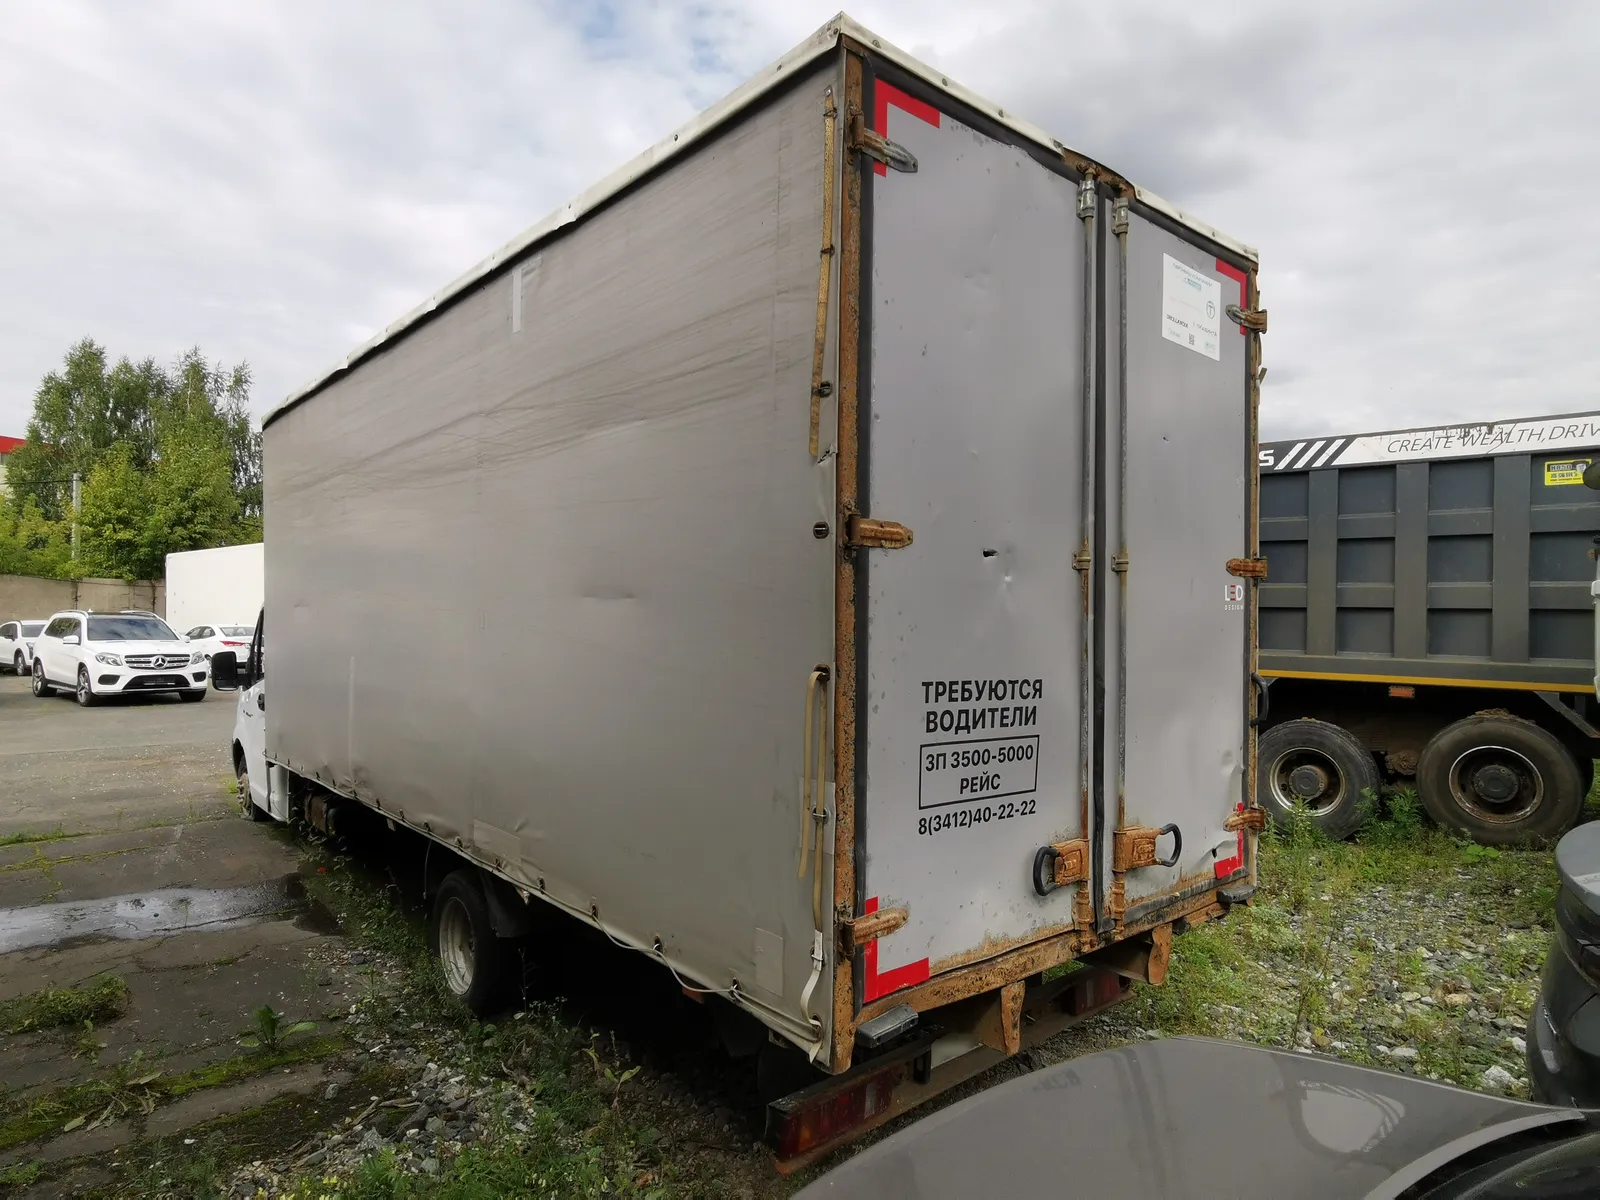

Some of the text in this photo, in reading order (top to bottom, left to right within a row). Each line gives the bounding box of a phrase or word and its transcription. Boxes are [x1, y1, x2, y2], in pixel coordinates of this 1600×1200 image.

[1387, 435, 1455, 453] CREATE
[1224, 584, 1244, 602] LED
[921, 678, 1043, 704] ТРЕБУЮТСЯ
[925, 705, 1037, 735] ВОДИТЕЛИ
[925, 744, 1034, 772] ЗП 3500-5000
[959, 771, 1001, 795] РЕЙС
[918, 799, 1036, 836] 8(3412)40-22-22
